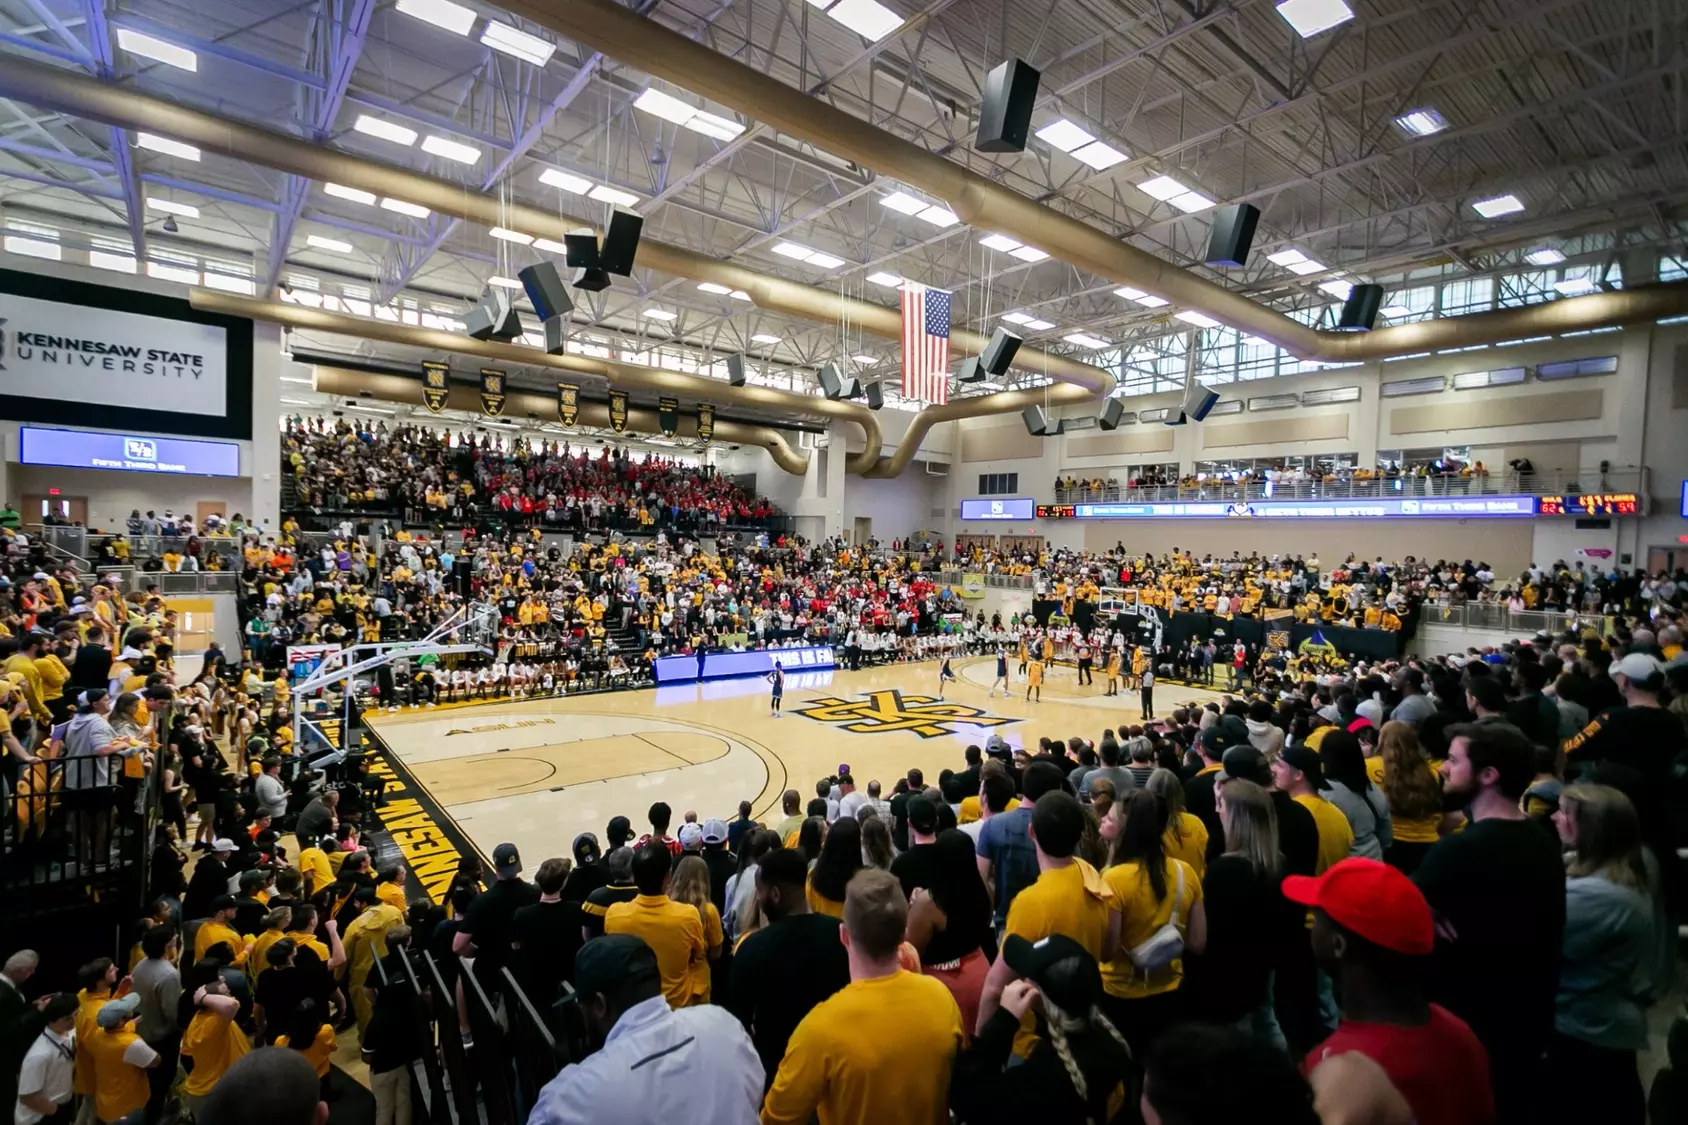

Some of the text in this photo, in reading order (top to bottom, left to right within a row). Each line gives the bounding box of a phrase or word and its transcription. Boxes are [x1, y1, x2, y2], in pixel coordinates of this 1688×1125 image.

[17, 330, 203, 368] KENNESAW STATE
[17, 346, 203, 380] UNIVERSITY
[768, 650, 801, 667] THIS
[801, 650, 816, 665] IS
